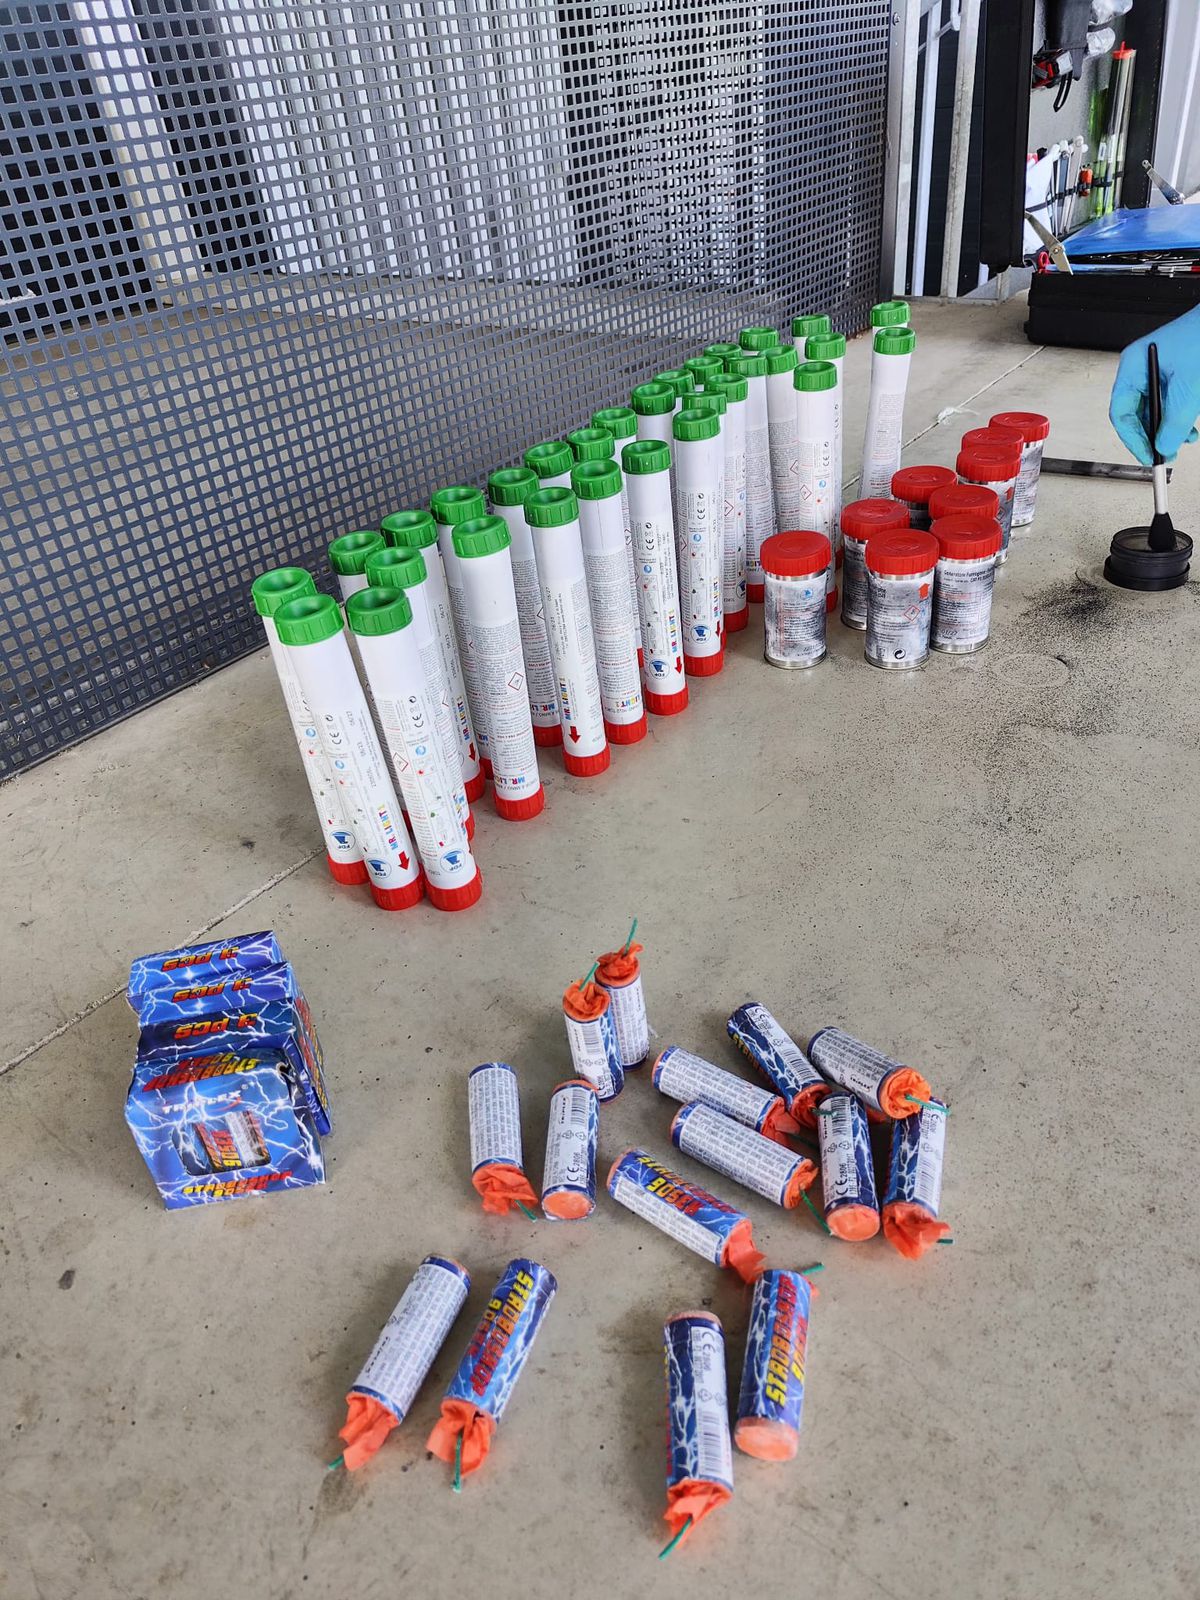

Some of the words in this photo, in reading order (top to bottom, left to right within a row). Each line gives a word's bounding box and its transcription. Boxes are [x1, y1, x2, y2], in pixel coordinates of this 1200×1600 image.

[161, 952, 211, 972] PCS
[172, 985, 225, 1003] PCS
[174, 1017, 229, 1039] PCS
[238, 1013, 257, 1028] 3
[470, 1270, 534, 1396] STROBOSKOP
[766, 1274, 797, 1405] STROBOSKOP
